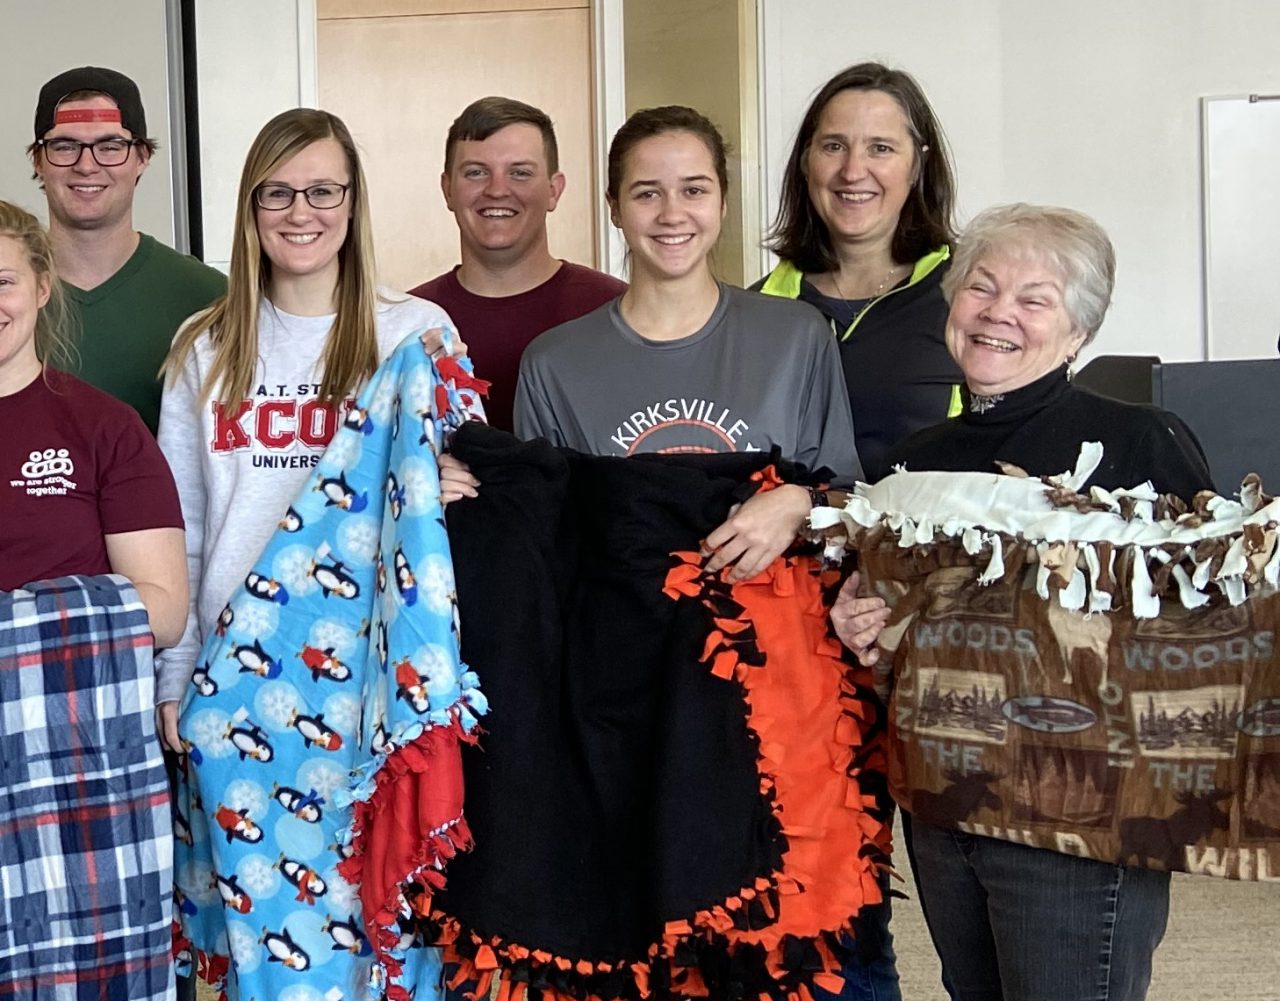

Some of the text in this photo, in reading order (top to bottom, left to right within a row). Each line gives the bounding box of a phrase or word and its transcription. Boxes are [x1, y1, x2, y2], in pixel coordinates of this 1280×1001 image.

[256, 384, 290, 397] A.T.
[211, 399, 357, 453] KCO
[610, 398, 749, 451] KIRKSVILLE
[252, 454, 321, 469] UNIVERS
[26, 486, 67, 497] together
[914, 619, 1038, 658] WOODS
[1122, 630, 1275, 671] WOODS
[918, 738, 983, 775] THE
[1148, 761, 1217, 791] THE
